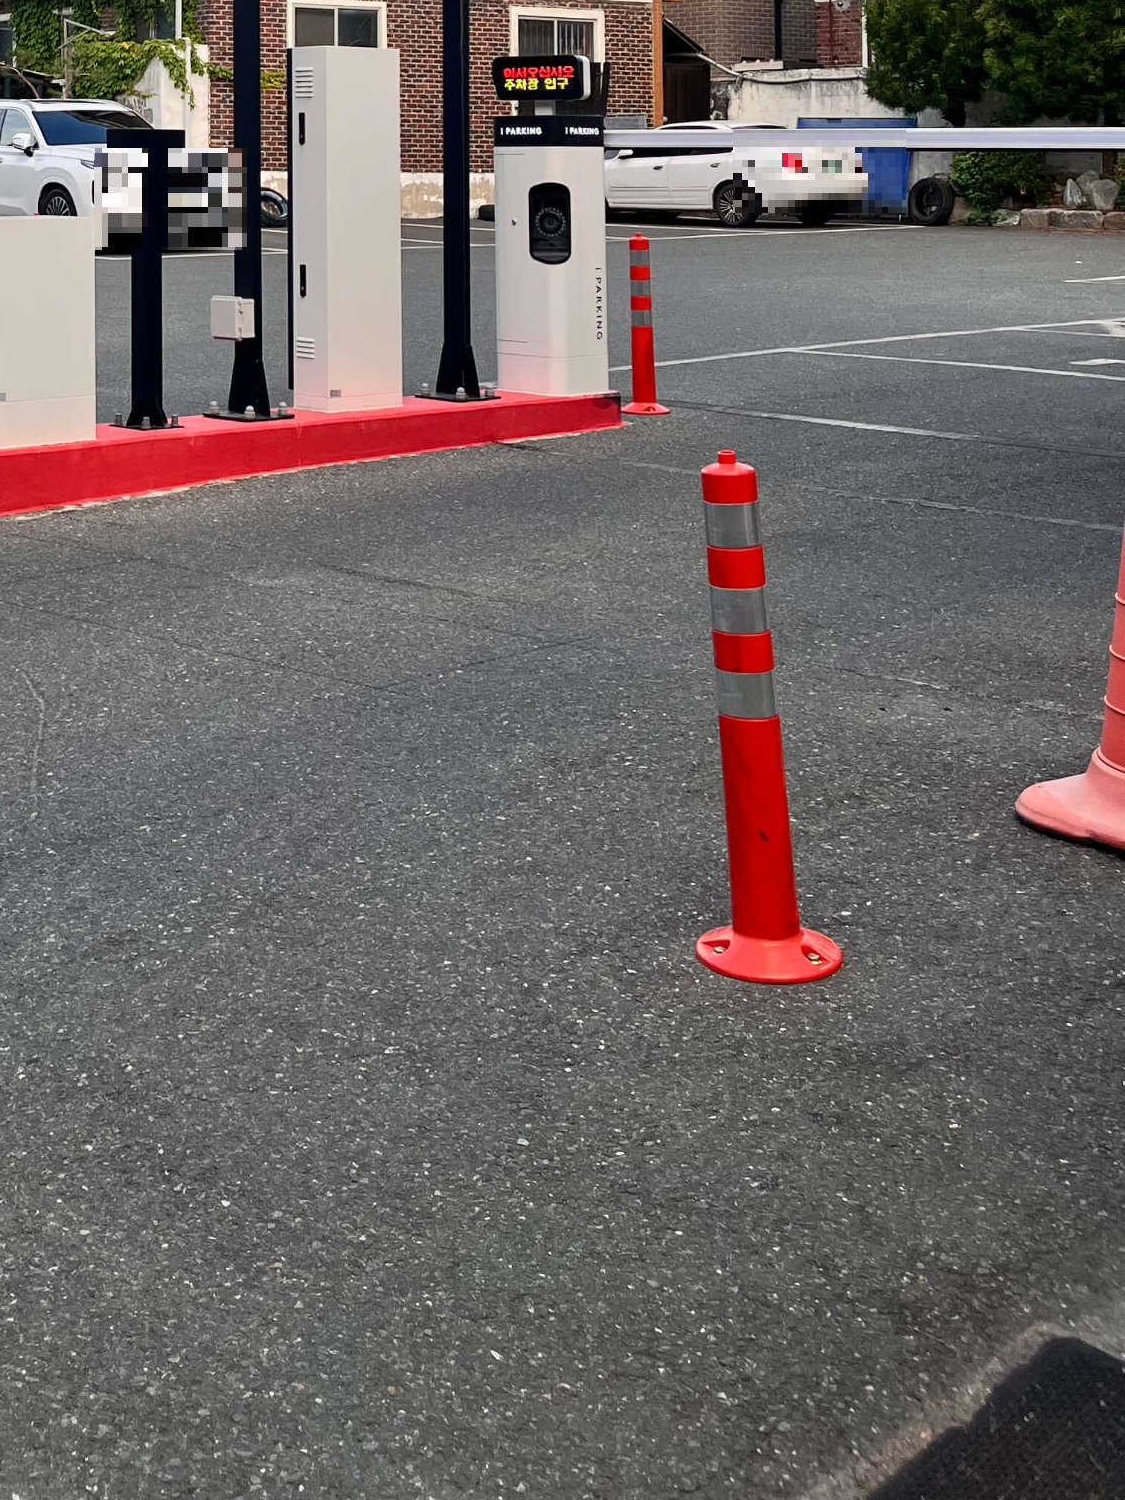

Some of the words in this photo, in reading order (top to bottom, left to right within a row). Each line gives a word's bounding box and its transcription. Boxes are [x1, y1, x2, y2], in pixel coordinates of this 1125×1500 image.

[504, 78, 539, 90] 주차장
[544, 77, 569, 90] 입구
[505, 127, 543, 136] PARKING
[569, 127, 599, 135] PARKING
[595, 277, 603, 340] PARKING
